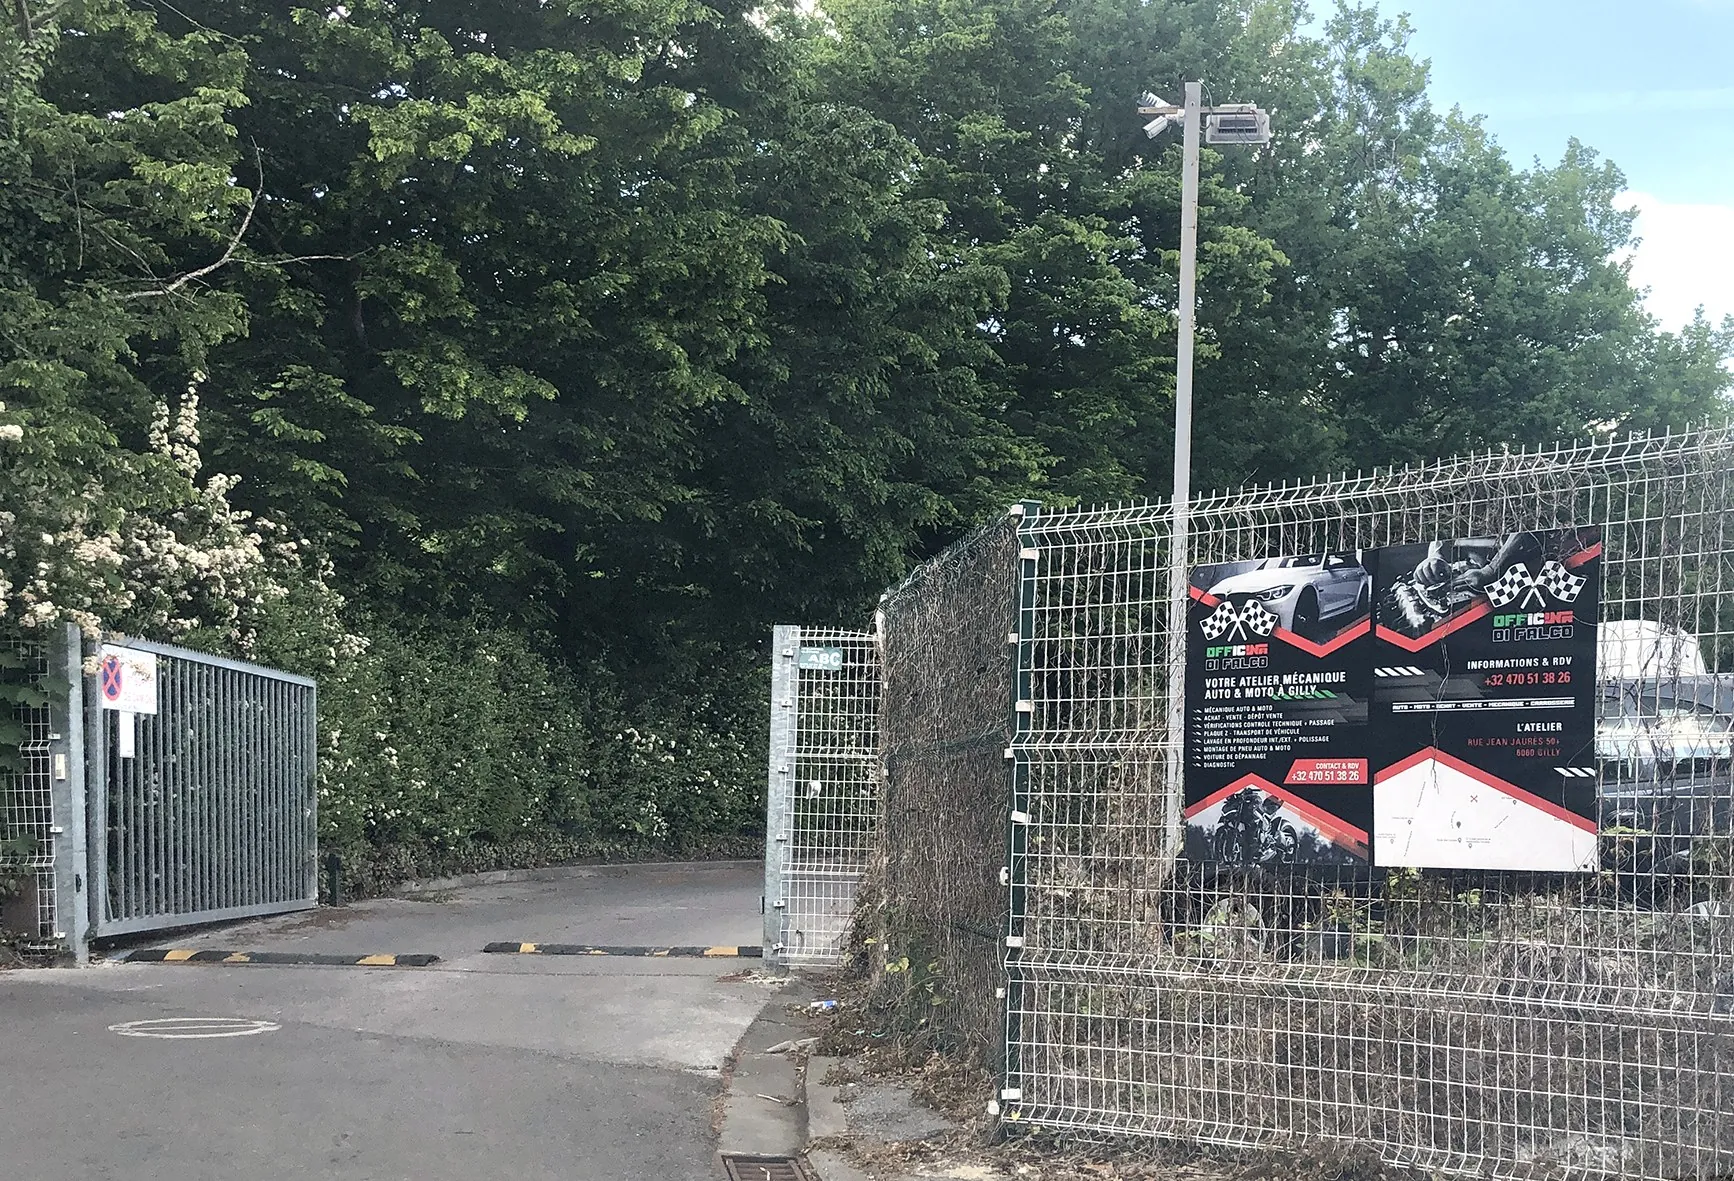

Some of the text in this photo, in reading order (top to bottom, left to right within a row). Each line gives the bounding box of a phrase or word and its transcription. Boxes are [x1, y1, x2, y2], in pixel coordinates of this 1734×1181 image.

[1492, 625, 1574, 642] DI FALCO
[808, 652, 840, 666] ABC
[1206, 656, 1268, 671] DI FALCO
[1467, 656, 1572, 670] INFORMATIONS & RDV
[1205, 672, 1346, 688] VOTRE ATELIER MÉCANIQUE
[1484, 671, 1571, 686] +32 470 51 38 26
[1204, 684, 1316, 700] AUTO & MOTO À GILLY
[1517, 722, 1562, 732] L'ATELIER
[1292, 771, 1359, 780] +32 470 51 38 26
